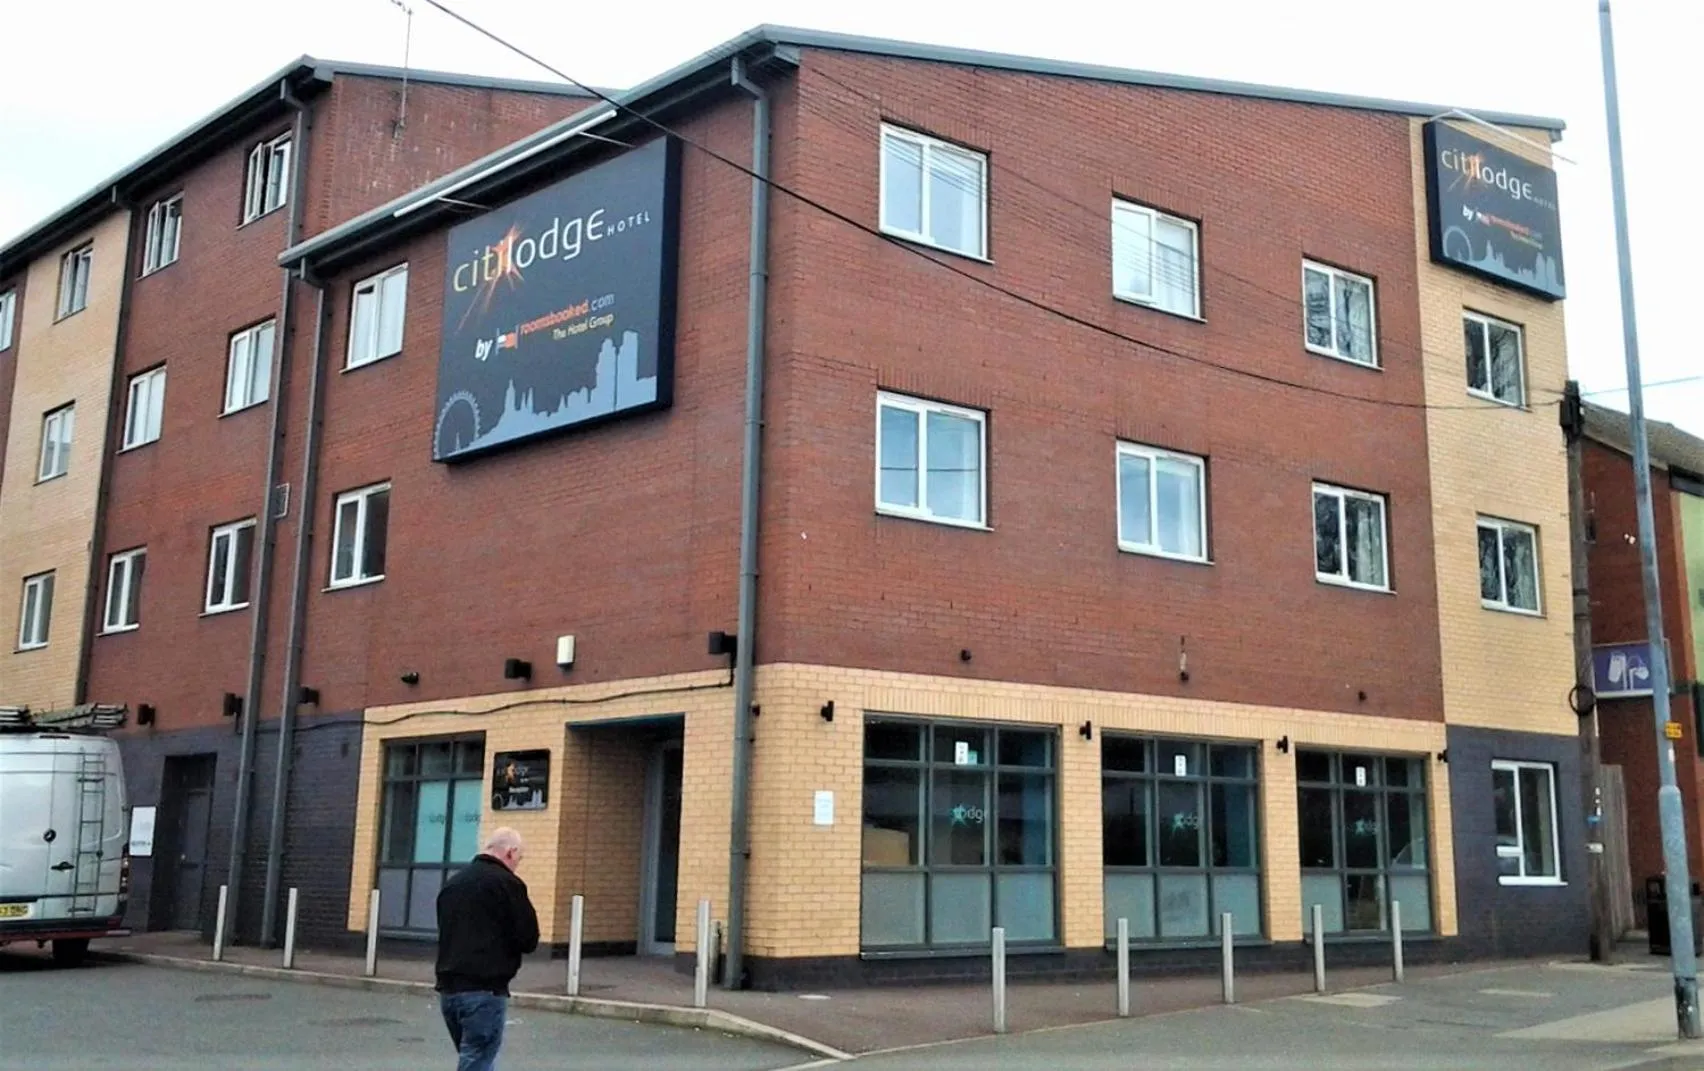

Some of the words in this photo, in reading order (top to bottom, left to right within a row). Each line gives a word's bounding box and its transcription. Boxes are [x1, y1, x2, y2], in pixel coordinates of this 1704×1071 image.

[1462, 204, 1474, 220] by
[607, 211, 650, 236] HOTEL
[589, 313, 614, 330] Group
[474, 338, 493, 361] by
